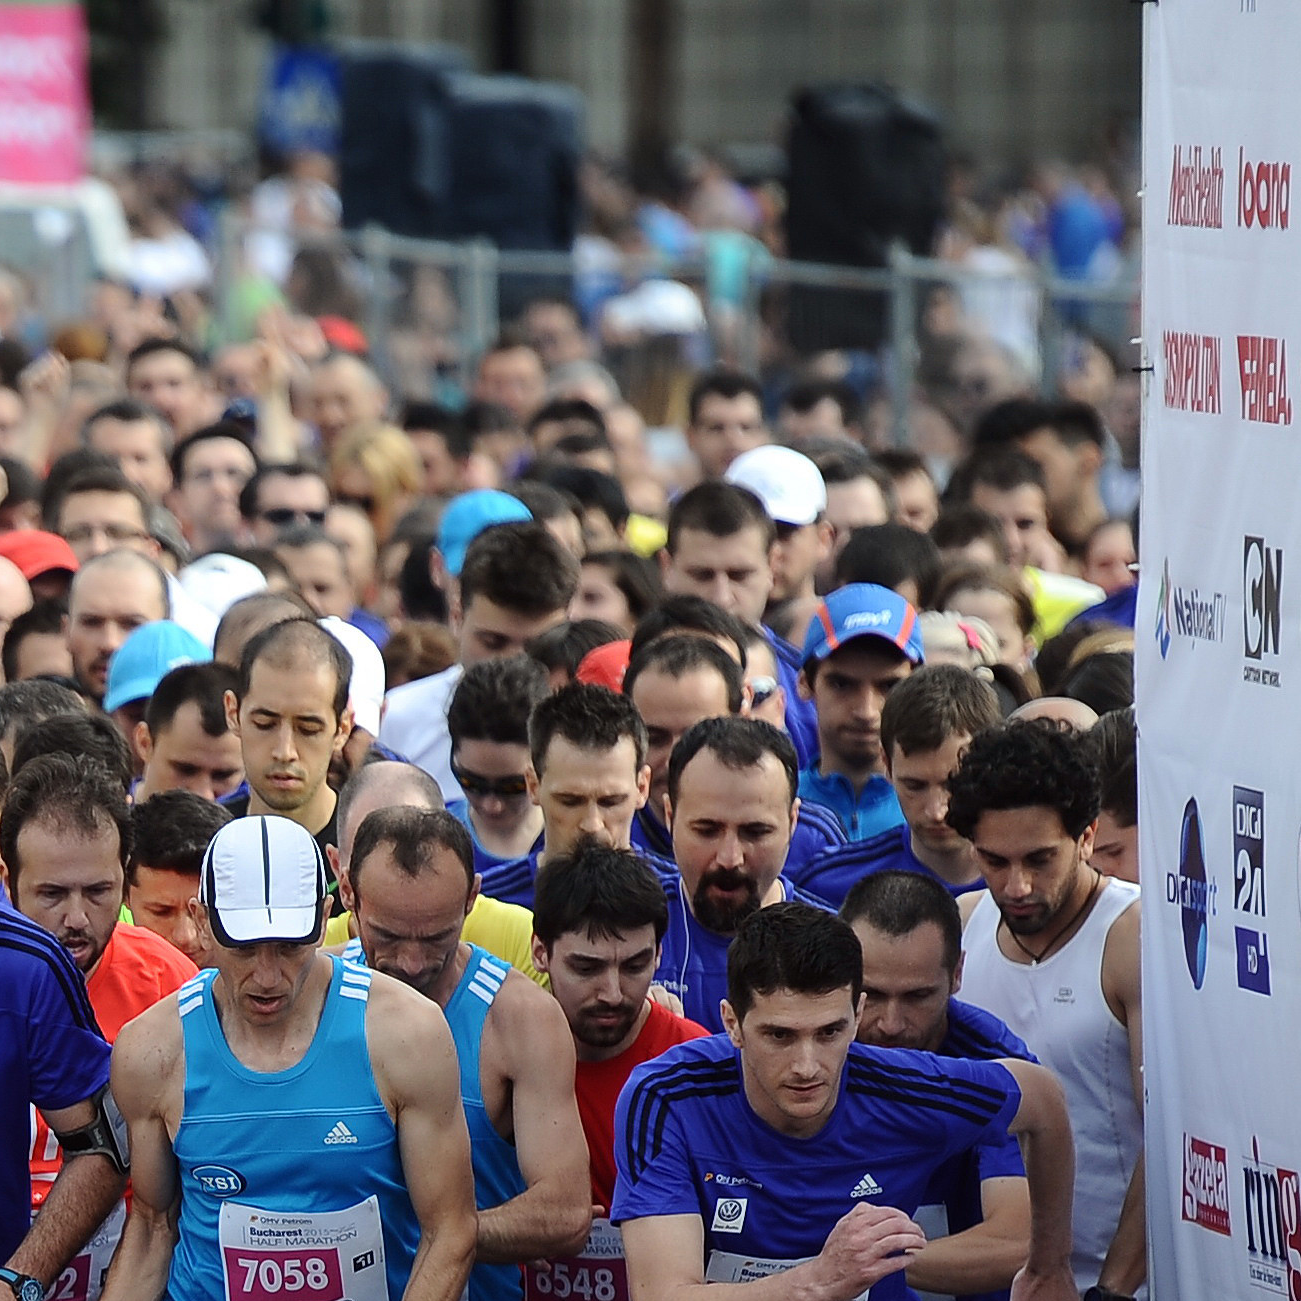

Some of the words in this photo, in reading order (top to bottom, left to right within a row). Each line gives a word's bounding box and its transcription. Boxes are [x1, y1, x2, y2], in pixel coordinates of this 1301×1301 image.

[1163, 330, 1222, 414] COSMOPOLITAN
[1236, 804, 1262, 839] DIGI
[1236, 849, 1263, 915] 24
[323, 1135, 358, 1145] adidas
[1184, 1135, 1228, 1221] gazeta
[850, 1186, 883, 1198] adidas
[249, 1226, 303, 1237] Bucharest
[304, 1228, 331, 1238] 2015
[260, 1216, 280, 1225] OMV
[281, 1217, 313, 1225] Petrom
[249, 1236, 282, 1246] HALF
[285, 1230, 358, 1246] MARATHON
[237, 1257, 329, 1293] 7058
